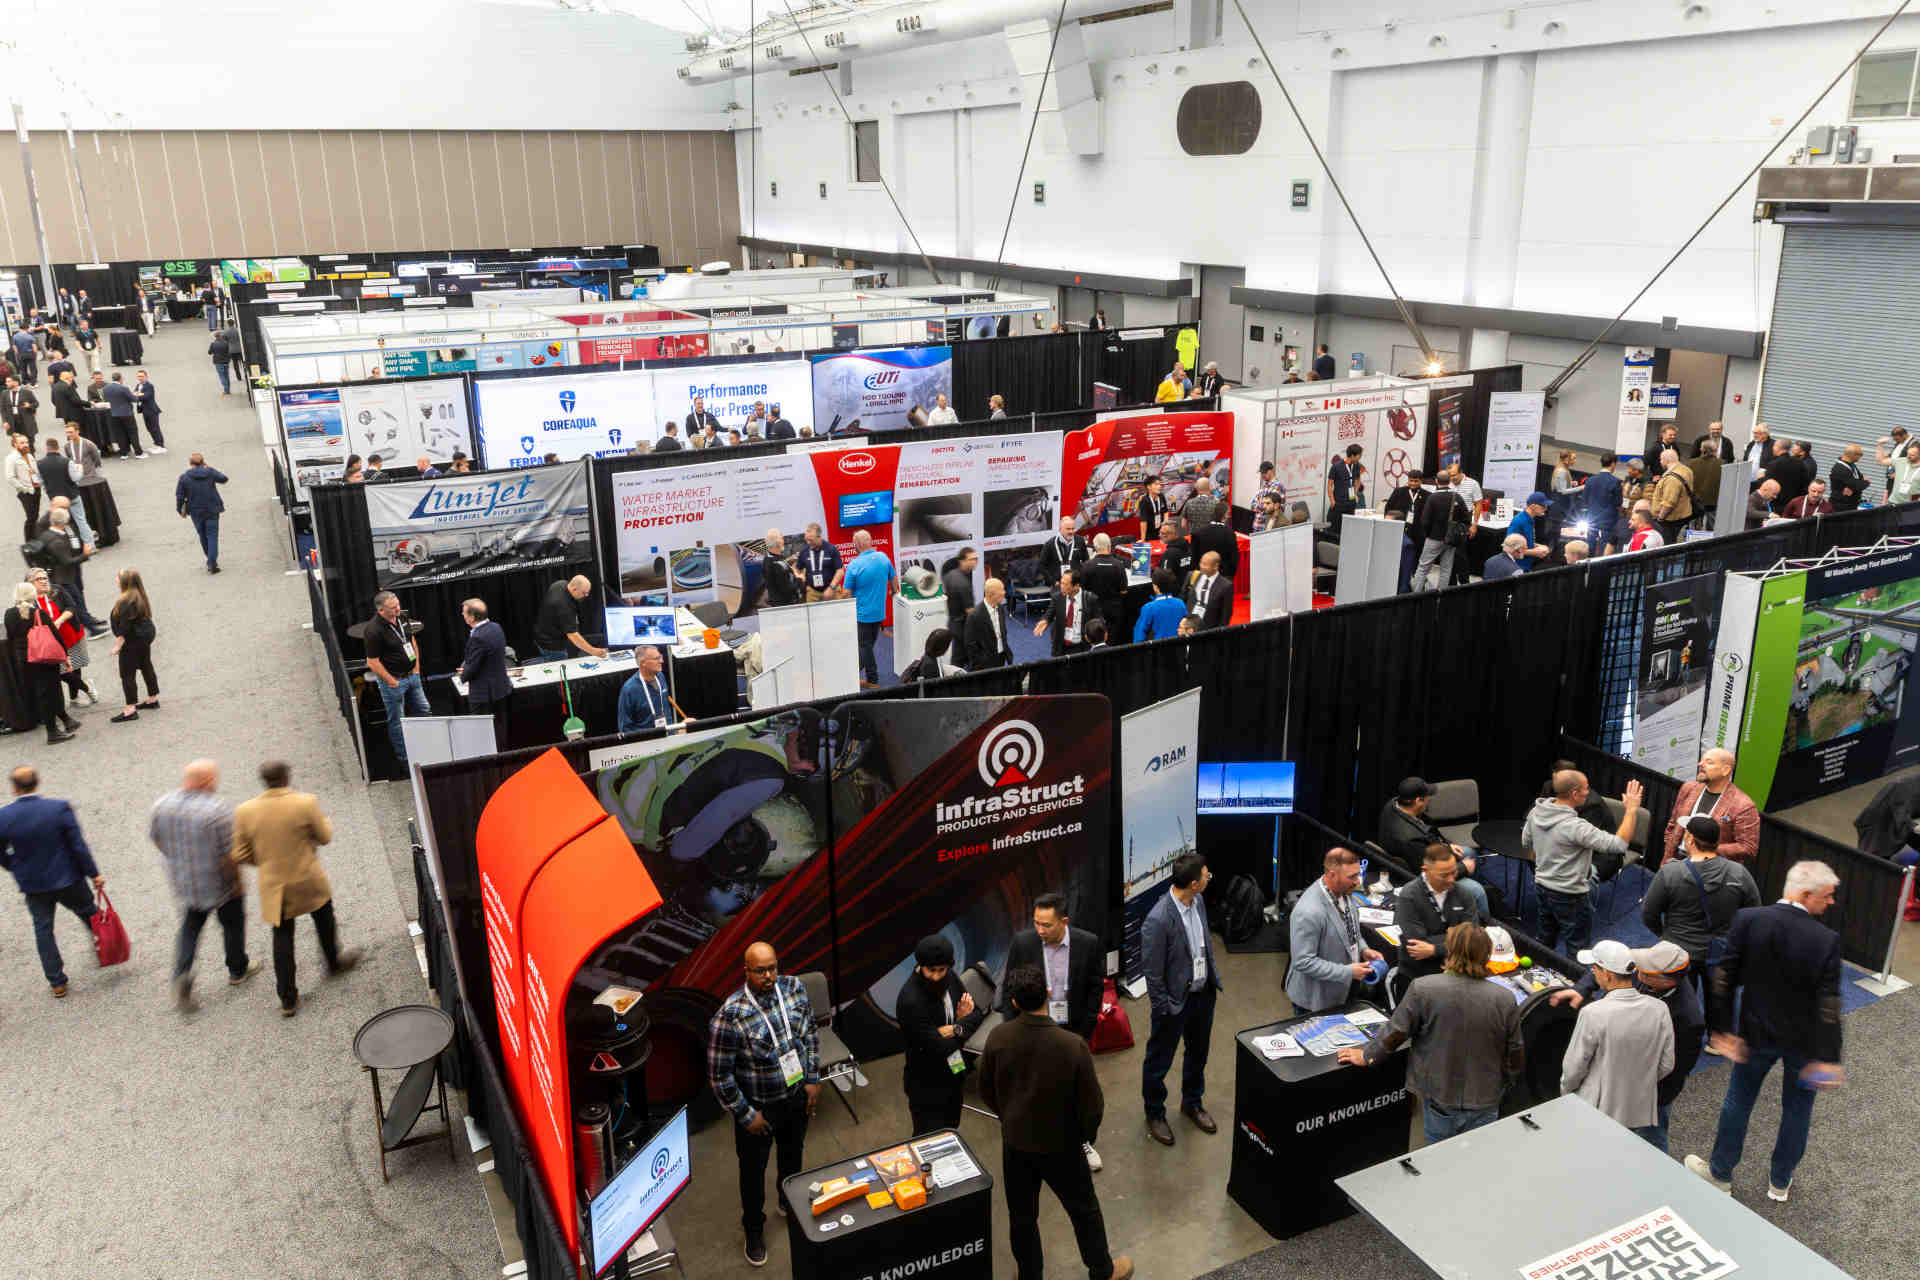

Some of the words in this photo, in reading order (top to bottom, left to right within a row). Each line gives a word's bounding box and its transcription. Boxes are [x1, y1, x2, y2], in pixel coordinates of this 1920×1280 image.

[689, 383, 767, 399] Performance
[543, 417, 597, 431] COREAQUA
[842, 457, 873, 469] Henkel
[622, 491, 662, 507] WATER
[665, 486, 713, 501] MARKET
[623, 496, 725, 519] INFRASTRUCTURE
[624, 511, 705, 530] PROTECTION
[1162, 745, 1187, 767] RAM
[936, 775, 1085, 822] infraStruct
[936, 813, 1000, 834] PRODUCTS
[1002, 807, 1027, 820] AND
[1029, 795, 1084, 815] SERVICES
[937, 842, 989, 863] Explore
[992, 822, 1082, 850] infraStruct.ca
[1295, 1115, 1324, 1134] OUR
[1328, 1088, 1407, 1124] KNOWLEDGE
[1653, 1213, 1673, 1226] BY
[1610, 1223, 1650, 1244] ARIES
[880, 1238, 985, 1280] KNOWLEDGE
[1529, 1241, 1610, 1279] INDUSTRIES
[1556, 1225, 1696, 1280] BLAZE
